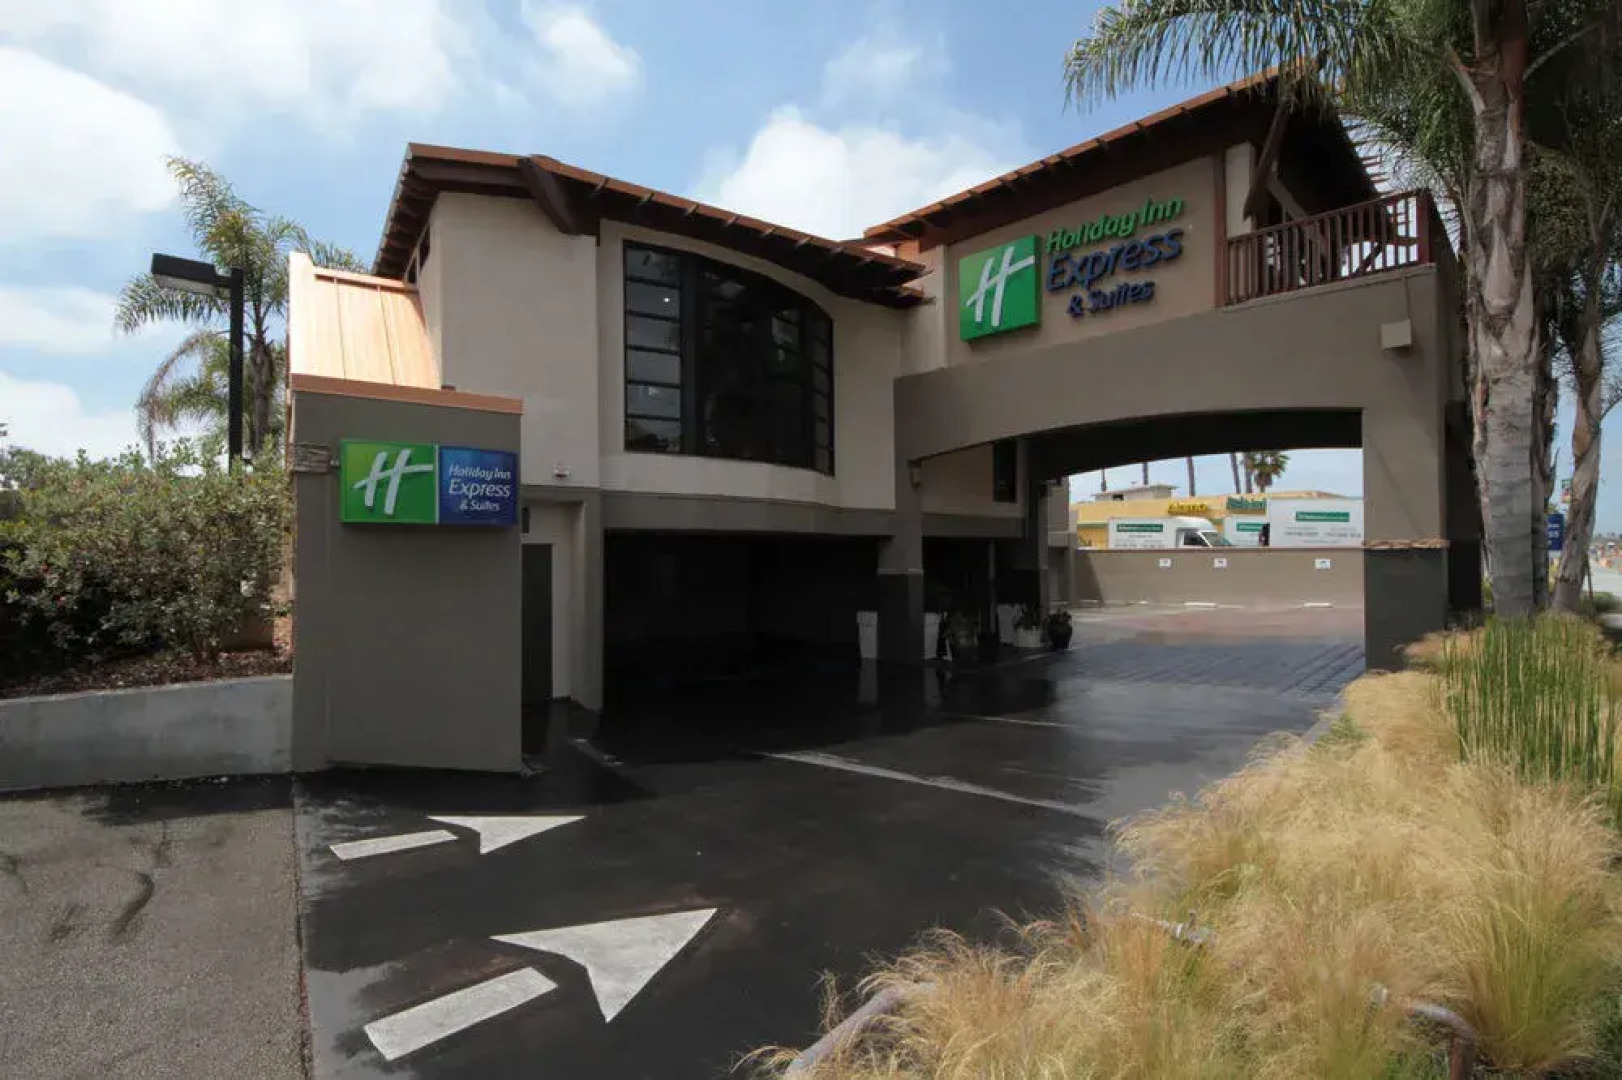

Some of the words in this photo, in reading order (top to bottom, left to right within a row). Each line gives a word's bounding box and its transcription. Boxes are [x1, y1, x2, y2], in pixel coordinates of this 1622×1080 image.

[1046, 213, 1137, 252] Holiday
[1139, 196, 1183, 225] Inn
[1046, 229, 1184, 292] Express
[1067, 295, 1085, 318] &
[1088, 281, 1156, 313] Suites
[449, 464, 494, 480] Holiday
[494, 468, 512, 479] Inn
[449, 479, 511, 498] Express
[460, 501, 469, 511] &
[470, 500, 500, 511] Suites
